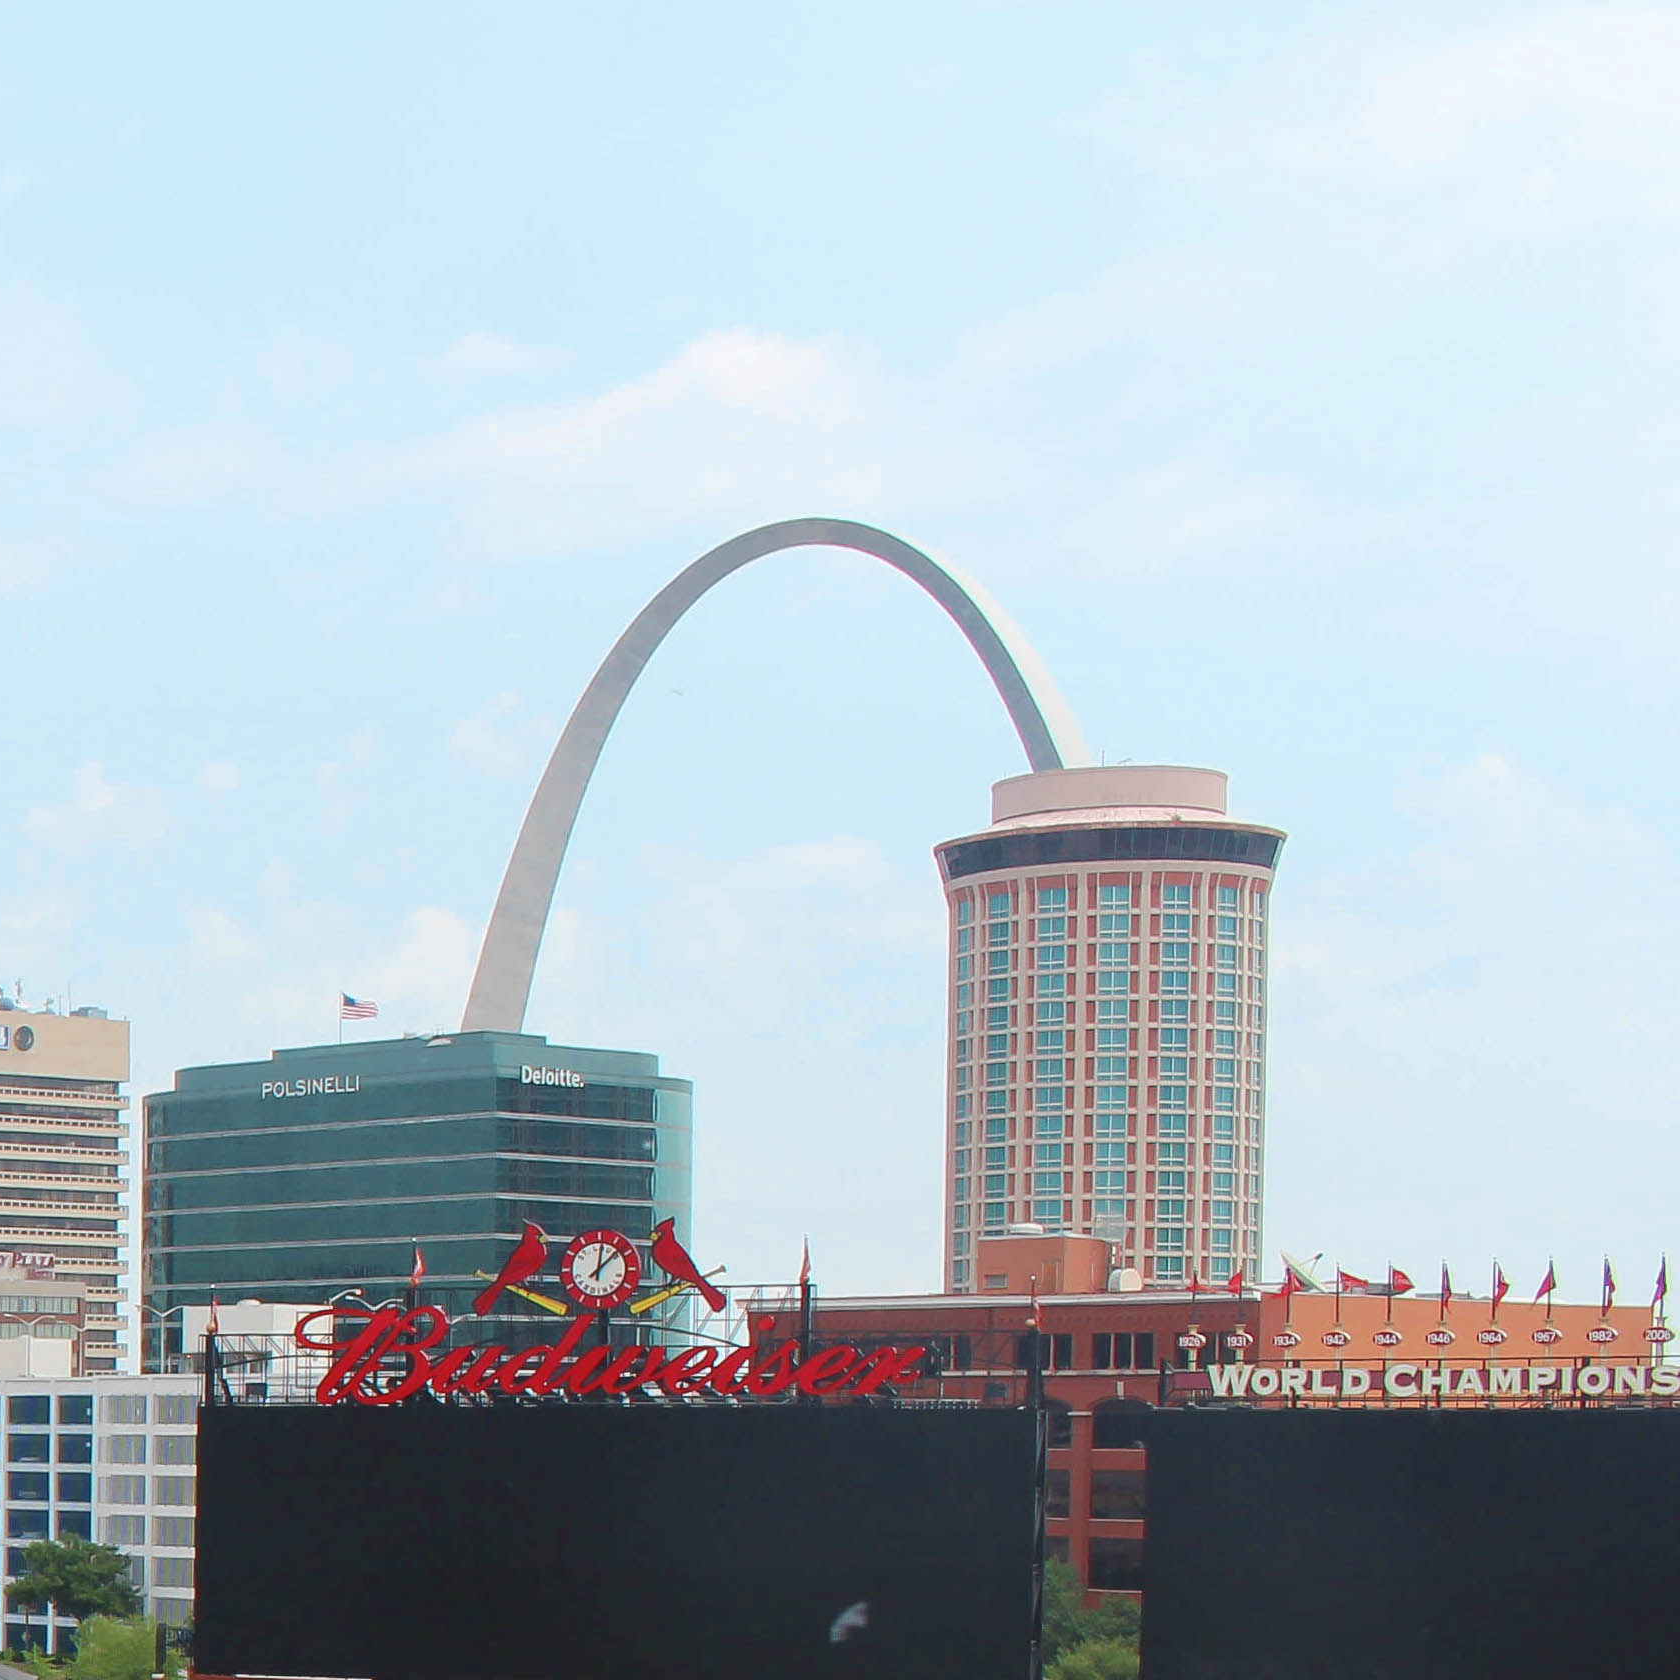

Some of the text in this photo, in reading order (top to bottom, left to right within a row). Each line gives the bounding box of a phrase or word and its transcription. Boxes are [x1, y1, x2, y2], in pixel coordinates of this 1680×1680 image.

[520, 1065, 585, 1089] Deloitte.
[261, 1075, 361, 1099] POLSINELLI
[1274, 1335, 1296, 1346] 1934
[1322, 1335, 1345, 1345] 1942
[1374, 1334, 1397, 1344] 1944
[1479, 1332, 1502, 1343] 1964
[1534, 1331, 1556, 1342] 1967
[1589, 1330, 1613, 1341] 1982
[1178, 1336, 1201, 1347] 1926
[1227, 1336, 1247, 1347] 1931
[295, 1306, 926, 1404] Budweiser
[1207, 1363, 1680, 1397] WORLD CHAMPIONS
